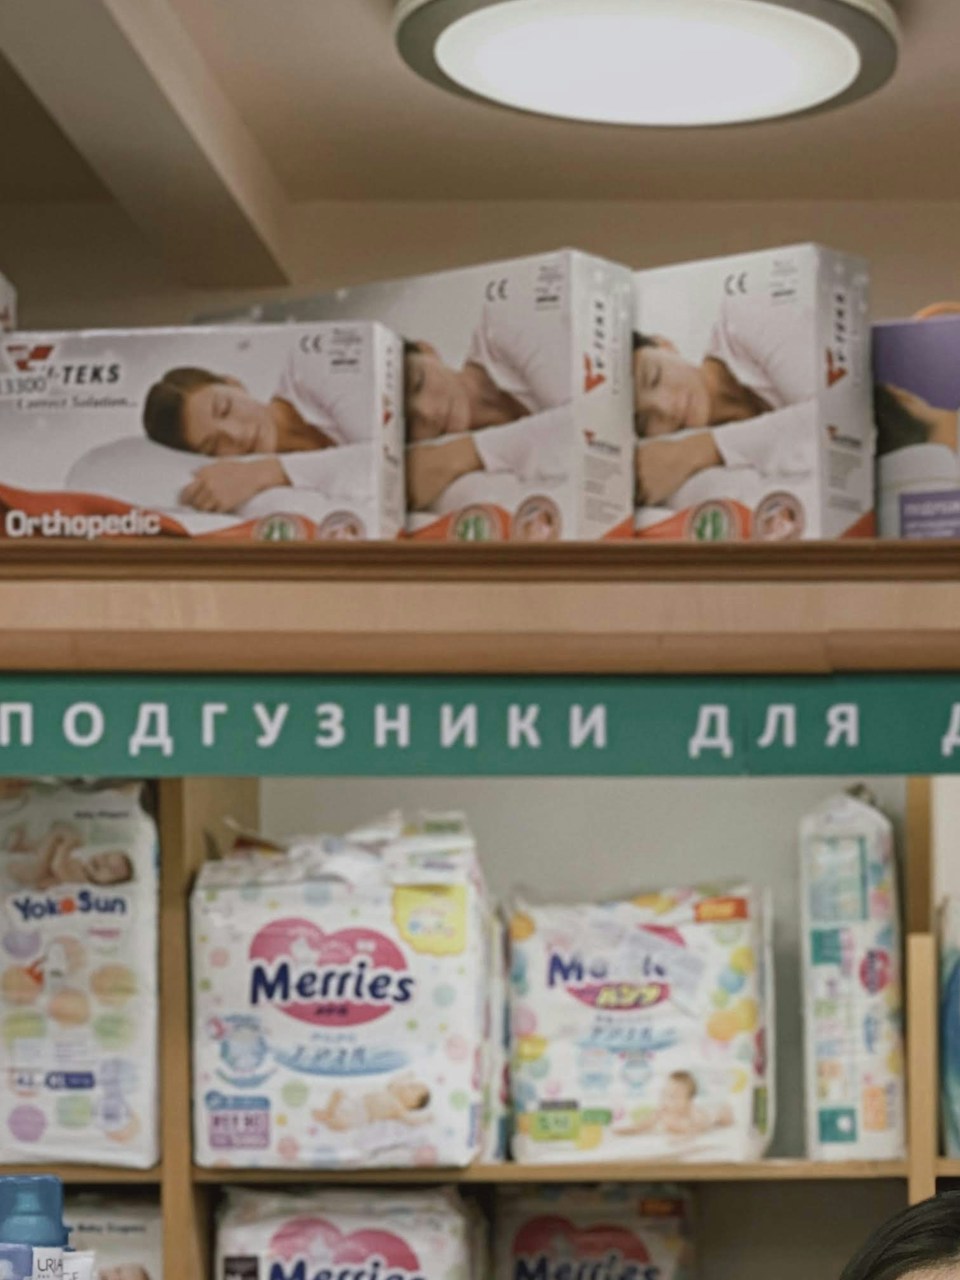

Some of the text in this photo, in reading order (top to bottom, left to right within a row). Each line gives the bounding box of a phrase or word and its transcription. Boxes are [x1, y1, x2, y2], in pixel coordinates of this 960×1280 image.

[5, 509, 160, 537] Orthopedic
[0, 702, 608, 756] ПОДГУЗНИКИ
[688, 704, 859, 758] ДЛЯ
[249, 961, 415, 1006] Merries
